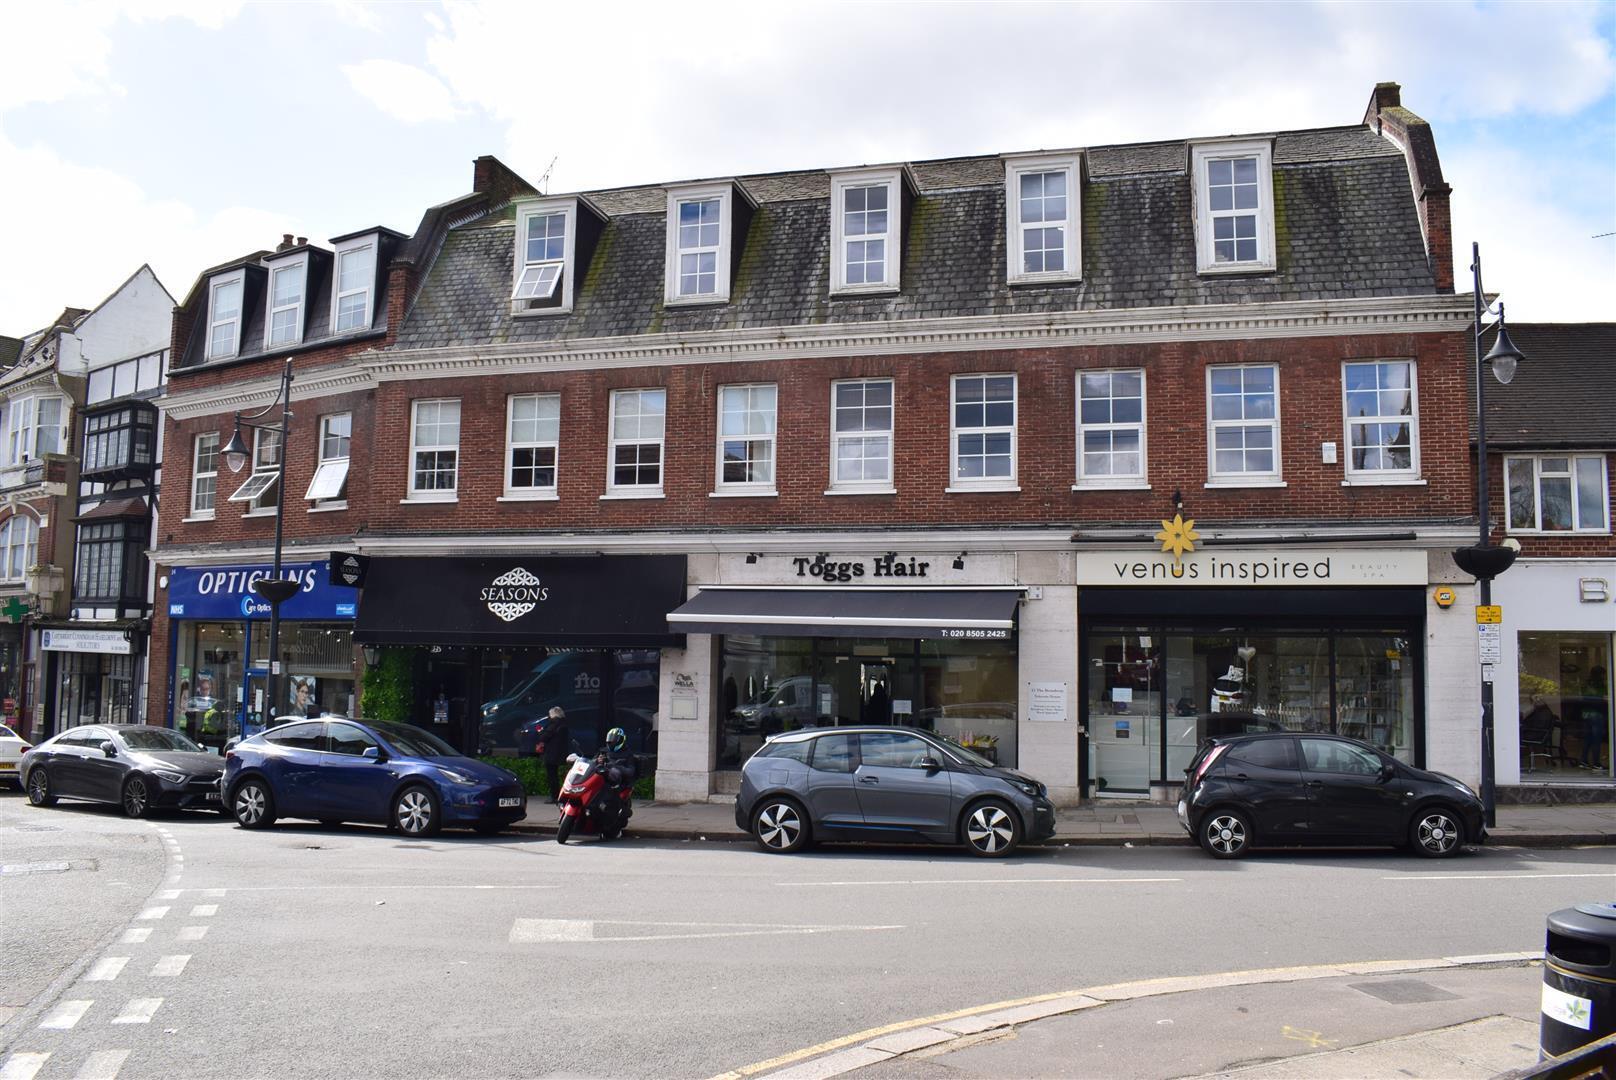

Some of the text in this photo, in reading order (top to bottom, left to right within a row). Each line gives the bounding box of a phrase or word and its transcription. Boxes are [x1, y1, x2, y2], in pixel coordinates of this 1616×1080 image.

[198, 568, 317, 594] OPTICNS
[793, 557, 929, 581] Toggs Hair
[1114, 557, 1331, 583] venus inspired
[480, 587, 549, 601] SEASONS
[170, 604, 184, 615] NHS
